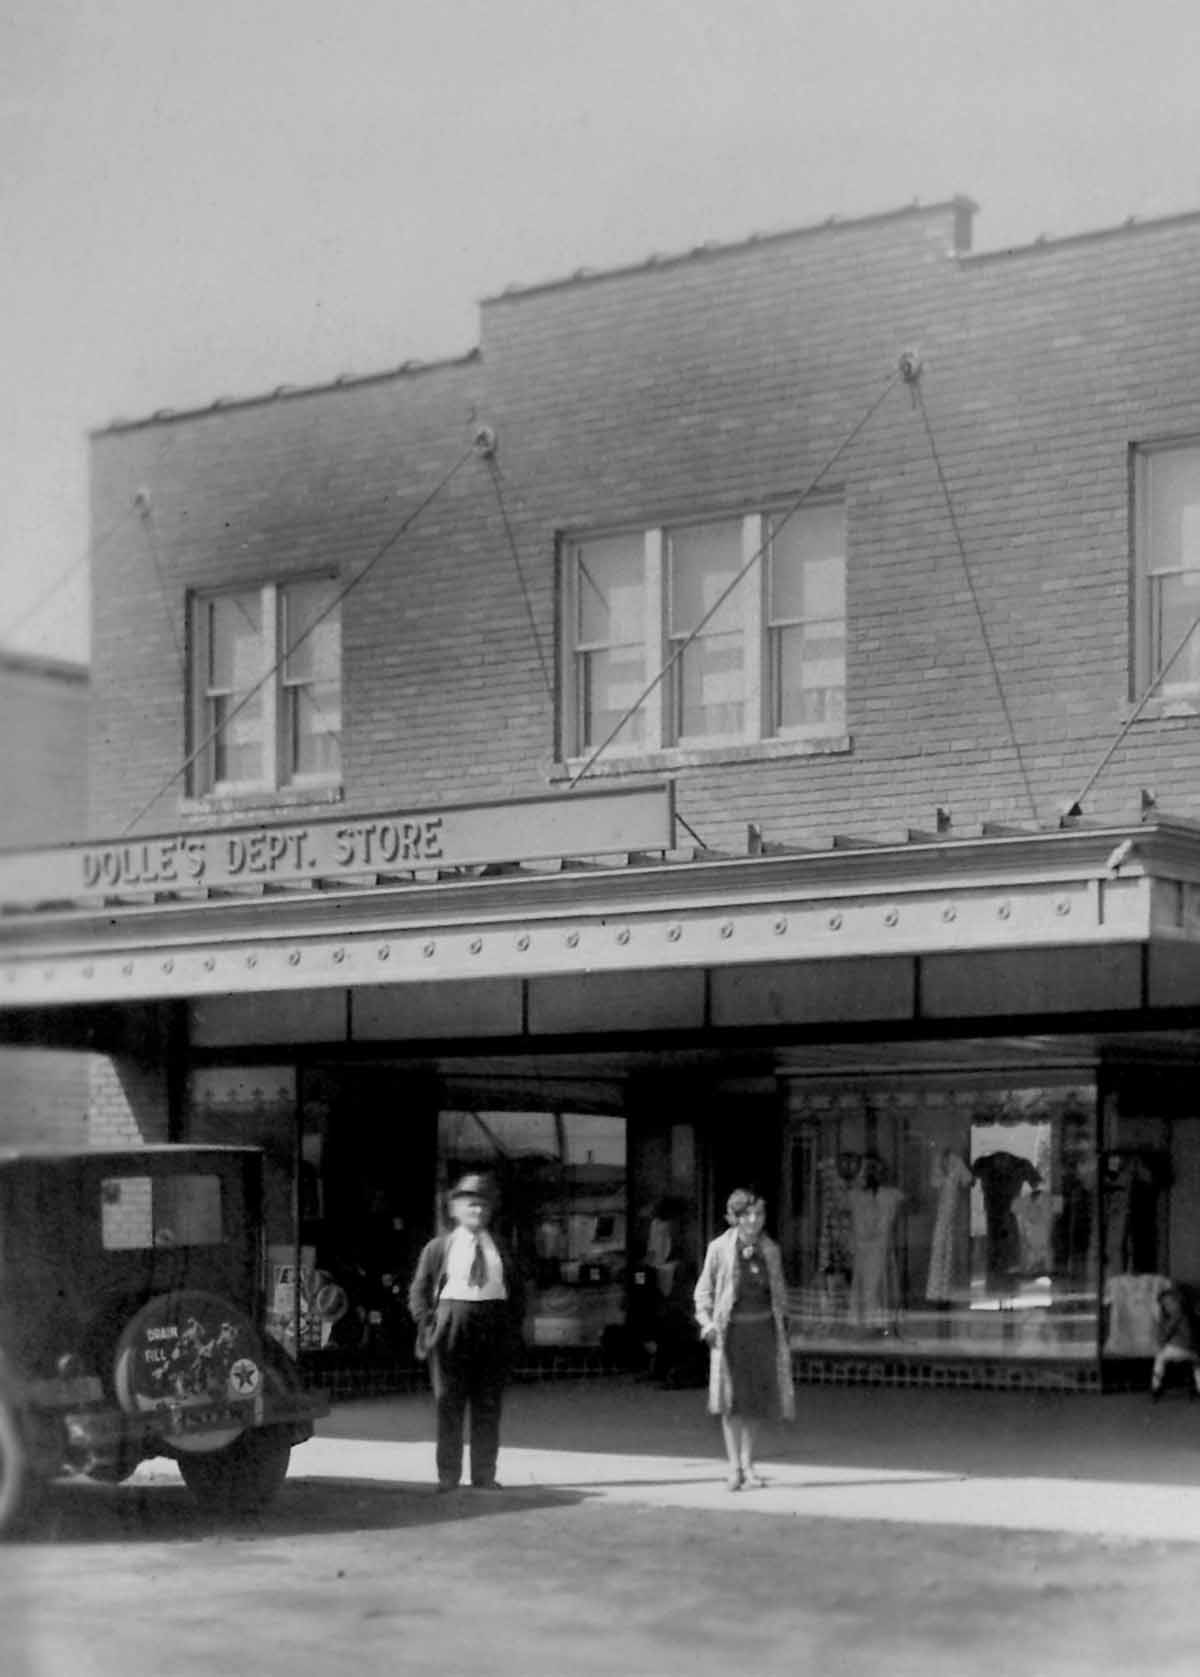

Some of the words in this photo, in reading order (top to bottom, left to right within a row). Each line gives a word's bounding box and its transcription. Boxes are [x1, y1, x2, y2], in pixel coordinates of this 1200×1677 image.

[84, 838, 205, 886] DOLLE'S
[229, 831, 317, 874] DEPT.
[336, 818, 443, 866] STORE
